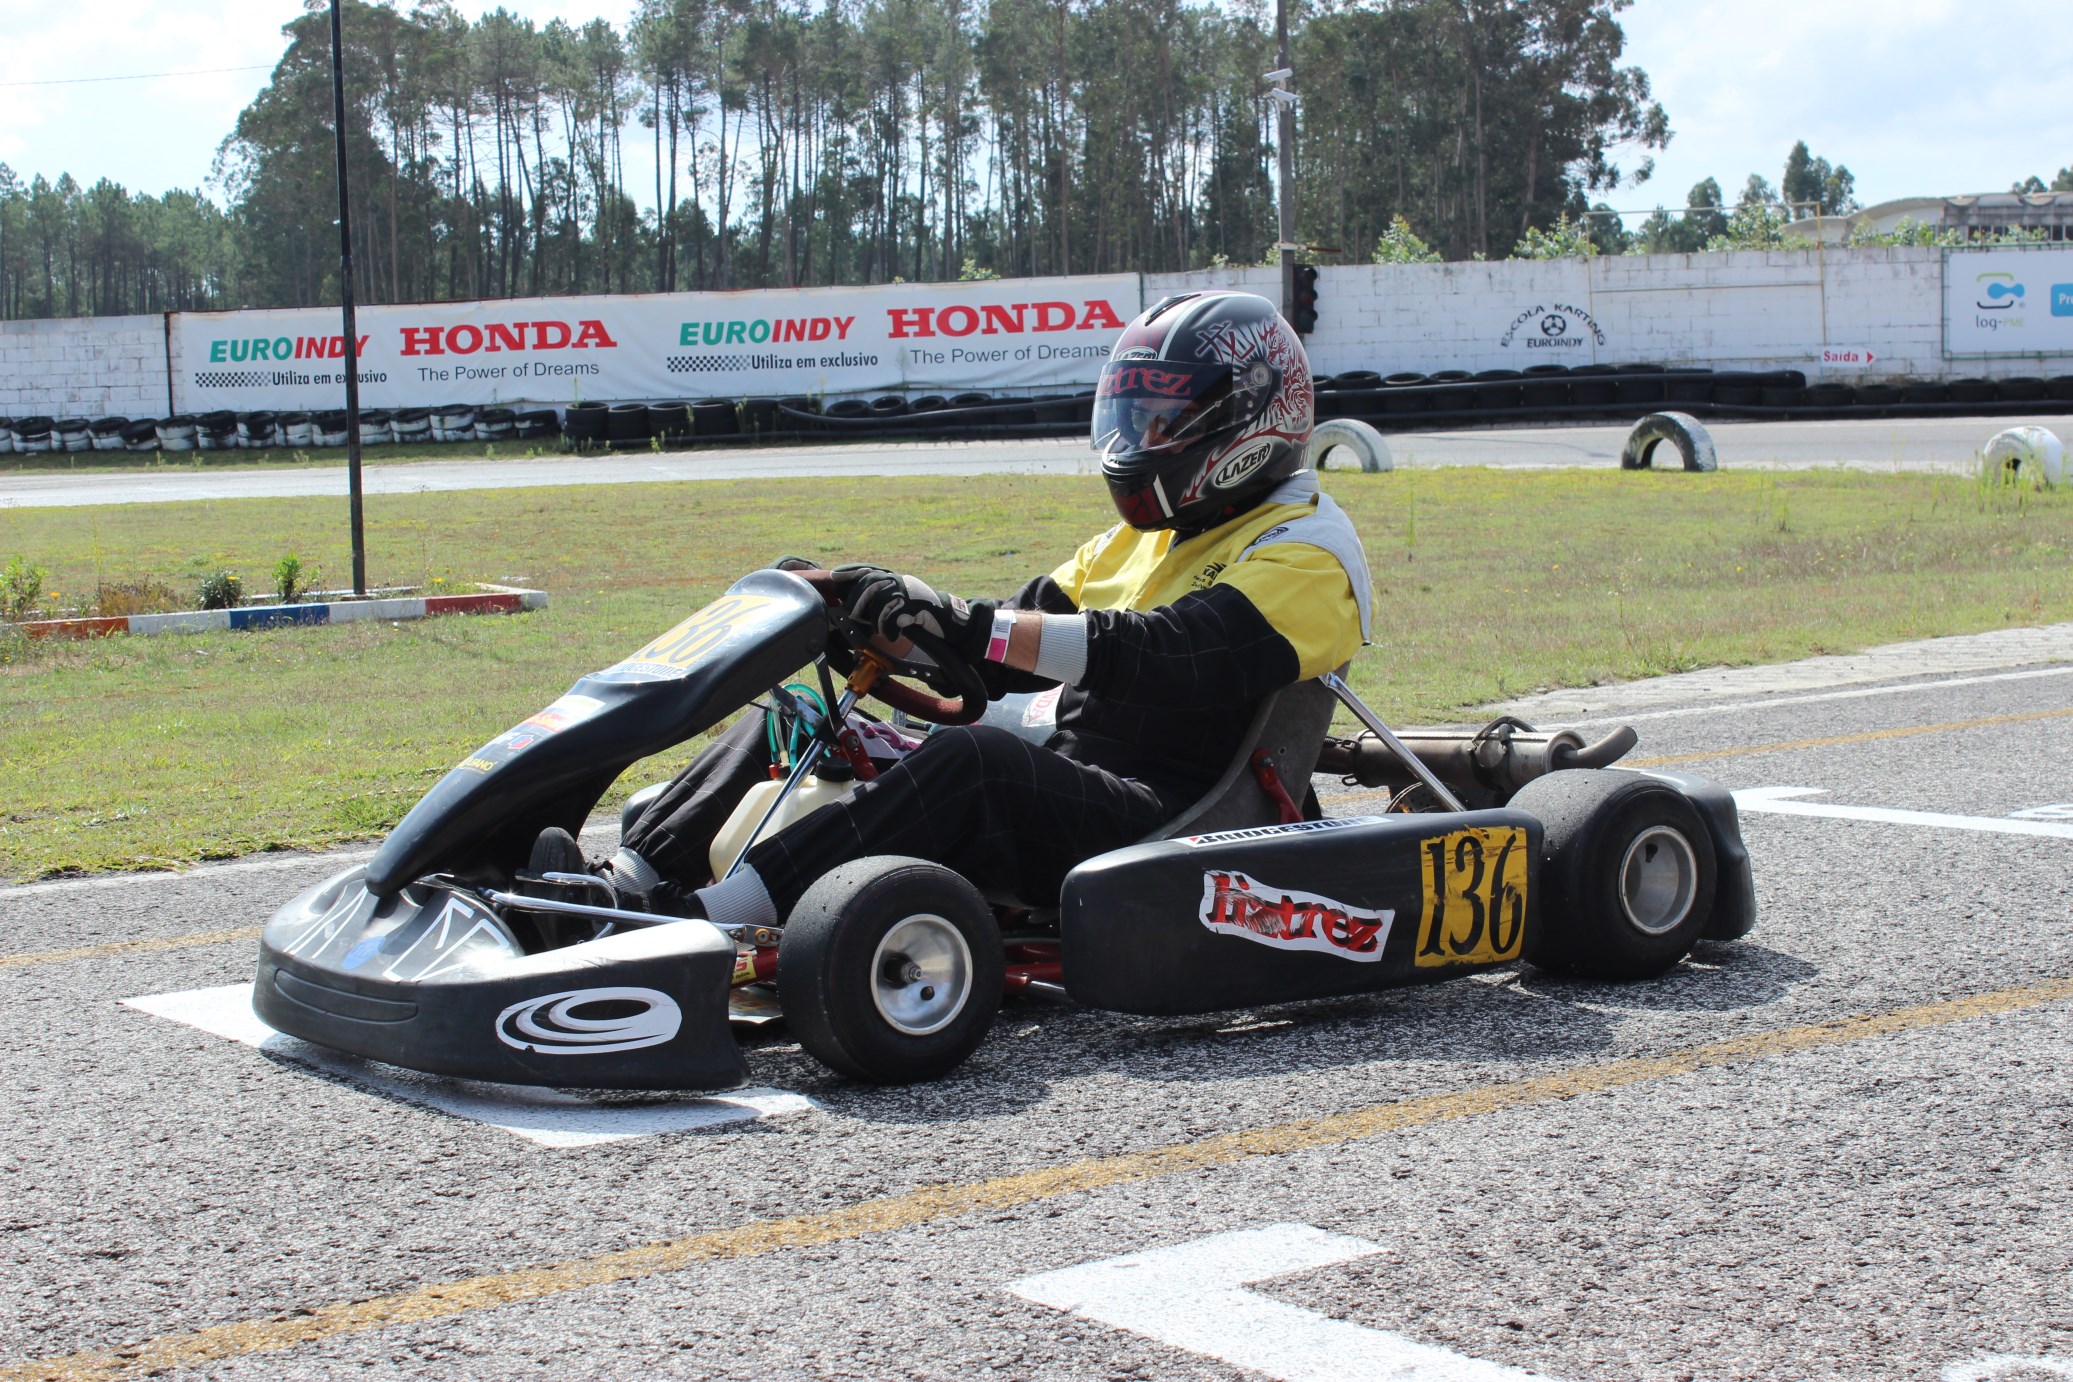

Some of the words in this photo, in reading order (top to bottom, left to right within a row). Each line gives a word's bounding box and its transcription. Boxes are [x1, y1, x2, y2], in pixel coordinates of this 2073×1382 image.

[679, 316, 855, 346] EUROINDY
[887, 299, 1126, 339] HONDA
[1501, 305, 1545, 348] ESCOLA
[1554, 304, 1606, 346] KARTING
[209, 335, 371, 363] EUROINDY
[400, 319, 617, 356] HONDA
[1527, 338, 1584, 348] EUROINDY
[751, 354, 794, 370] Utiliza
[796, 357, 819, 369] em
[820, 352, 878, 368] exclusivo
[911, 348, 945, 364] The
[951, 347, 1007, 364] Power
[1015, 345, 1033, 361] of
[1038, 344, 1111, 360] Dreams
[271, 370, 310, 386] Utiliza
[313, 373, 332, 385] em
[335, 370, 387, 384] exusivo
[418, 367, 450, 382] The
[454, 365, 508, 380] Power
[512, 362, 530, 377] of
[534, 361, 600, 377] Dreams
[1222, 446, 1268, 481] LAZER
[1202, 816, 1372, 844] BRIDGESTONE
[1419, 833, 1523, 957] 136
